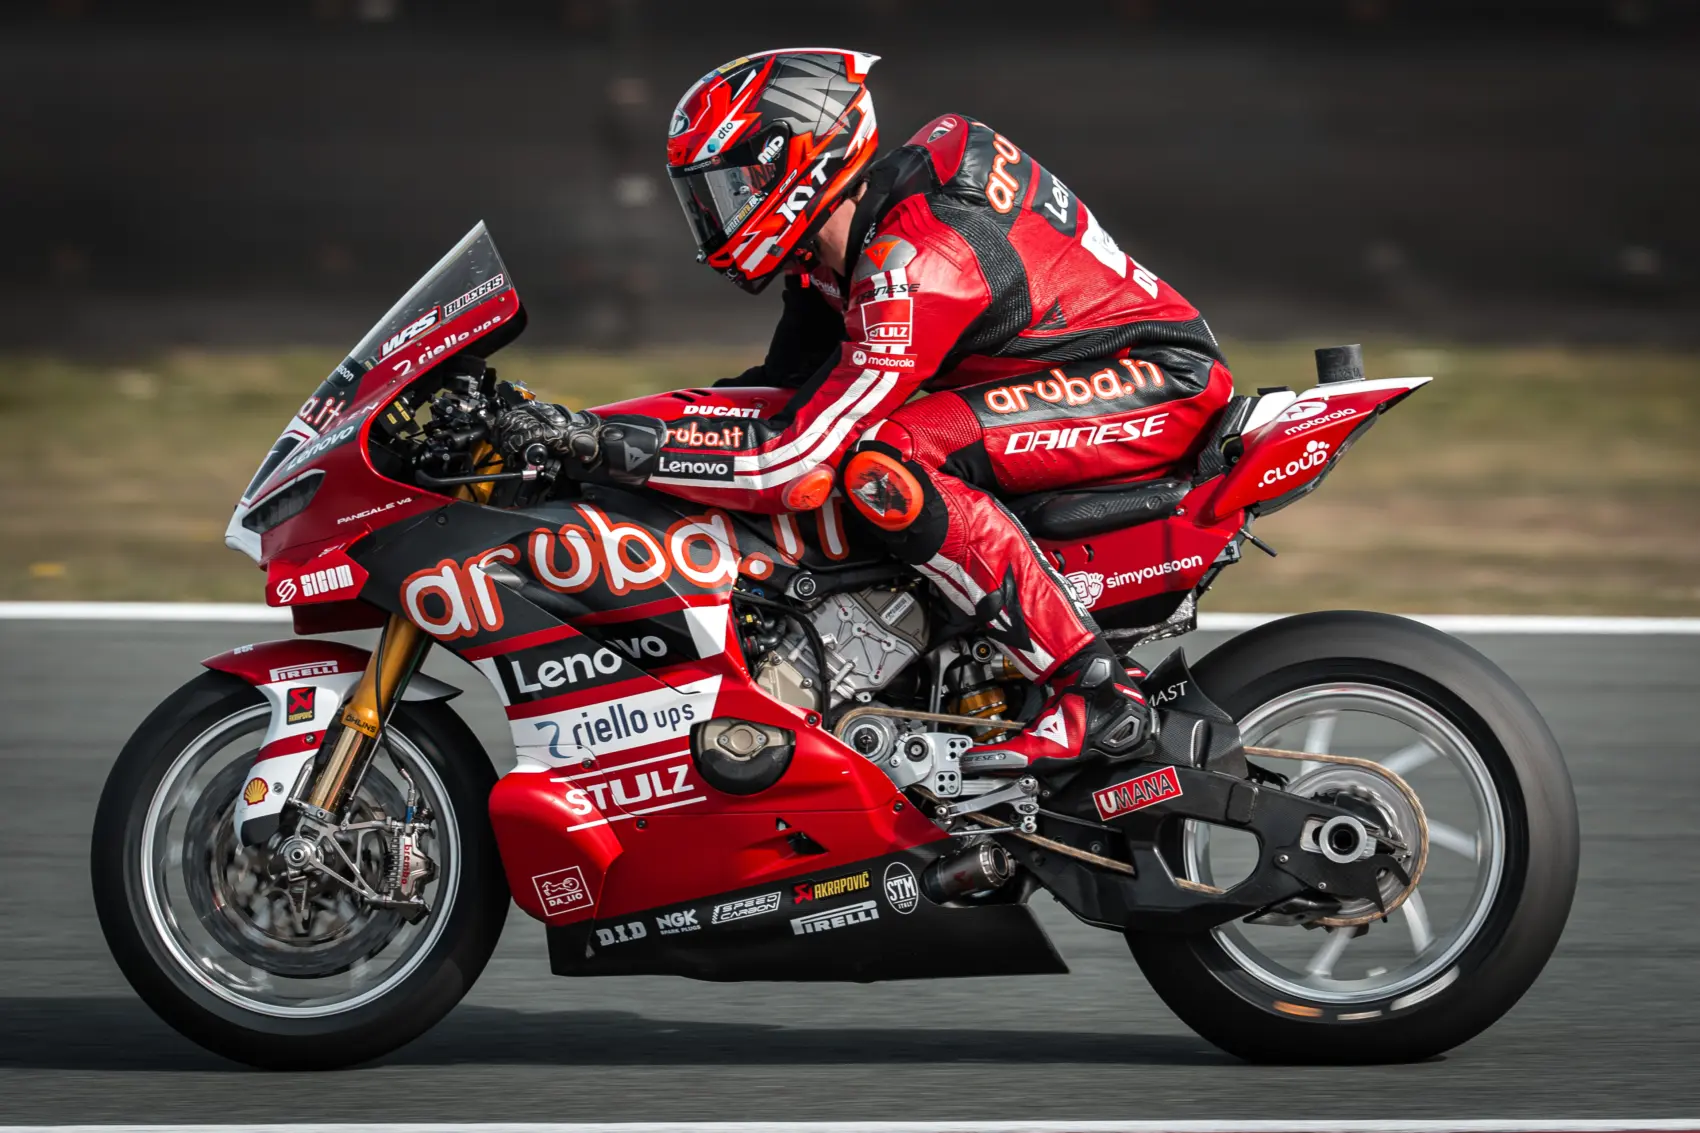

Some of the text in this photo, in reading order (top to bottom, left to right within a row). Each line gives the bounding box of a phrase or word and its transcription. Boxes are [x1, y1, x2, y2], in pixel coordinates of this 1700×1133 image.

[717, 122, 734, 140] dto
[776, 152, 832, 224] KYT
[445, 277, 502, 316] BULEGAS
[418, 315, 502, 365] riello ups
[868, 356, 915, 368] motorola
[984, 358, 1165, 414] aruba.it
[683, 405, 761, 419] DUCATI
[1284, 407, 1357, 436] motorola
[287, 426, 355, 472] Lenovo
[664, 421, 744, 449] ruba.it
[1004, 412, 1170, 455] DAINESE
[659, 456, 729, 475] Lenovo
[337, 502, 396, 525] PANIGALE
[300, 564, 354, 598] SICOM
[1106, 555, 1203, 589] simyousoon
[269, 660, 340, 683] PIRELLI
[511, 635, 668, 694] Lenovo
[572, 703, 695, 750] riello ups
[565, 764, 695, 816] STULZ
[1098, 773, 1176, 815] UMANA
[401, 844, 413, 885] brembo
[814, 870, 870, 899] AKRAPOVIČ
[886, 876, 917, 902] STM
[655, 908, 699, 930] NGK
[720, 902, 777, 921] CARBON
[722, 894, 778, 913] SPEED
[789, 900, 880, 936] PIRELLI
[595, 921, 648, 946] D.I.D
